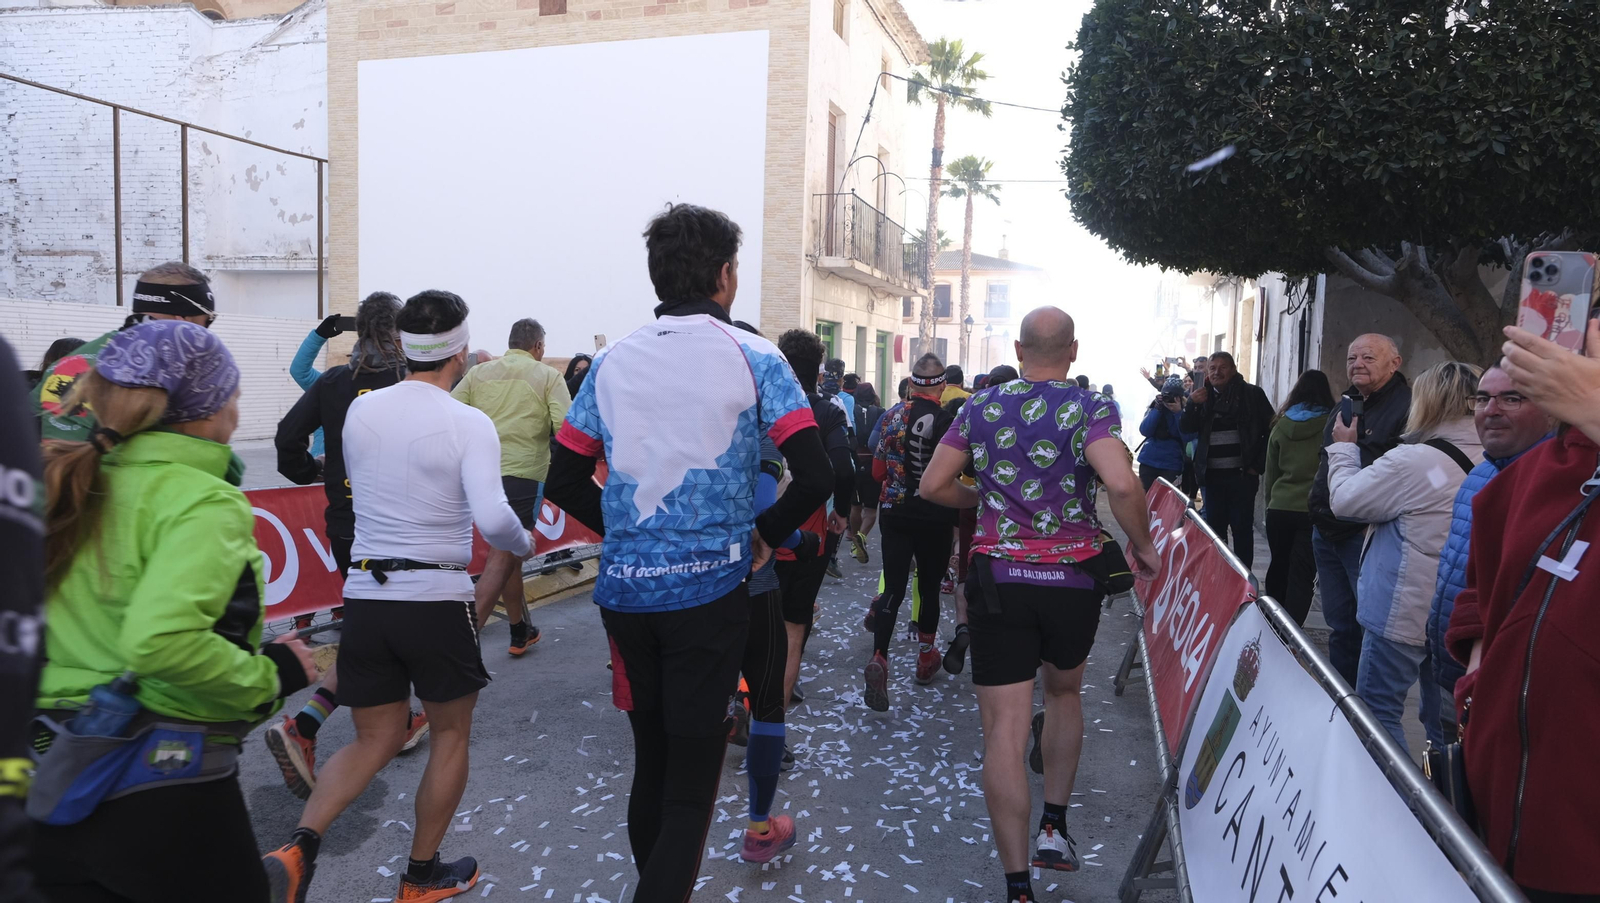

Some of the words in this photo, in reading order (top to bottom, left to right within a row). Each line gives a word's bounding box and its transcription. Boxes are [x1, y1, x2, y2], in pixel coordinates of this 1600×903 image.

[1008, 567, 1022, 577] LOS
[1022, 569, 1065, 580] SALTABOJAS
[1166, 577, 1215, 693] VEOLIA
